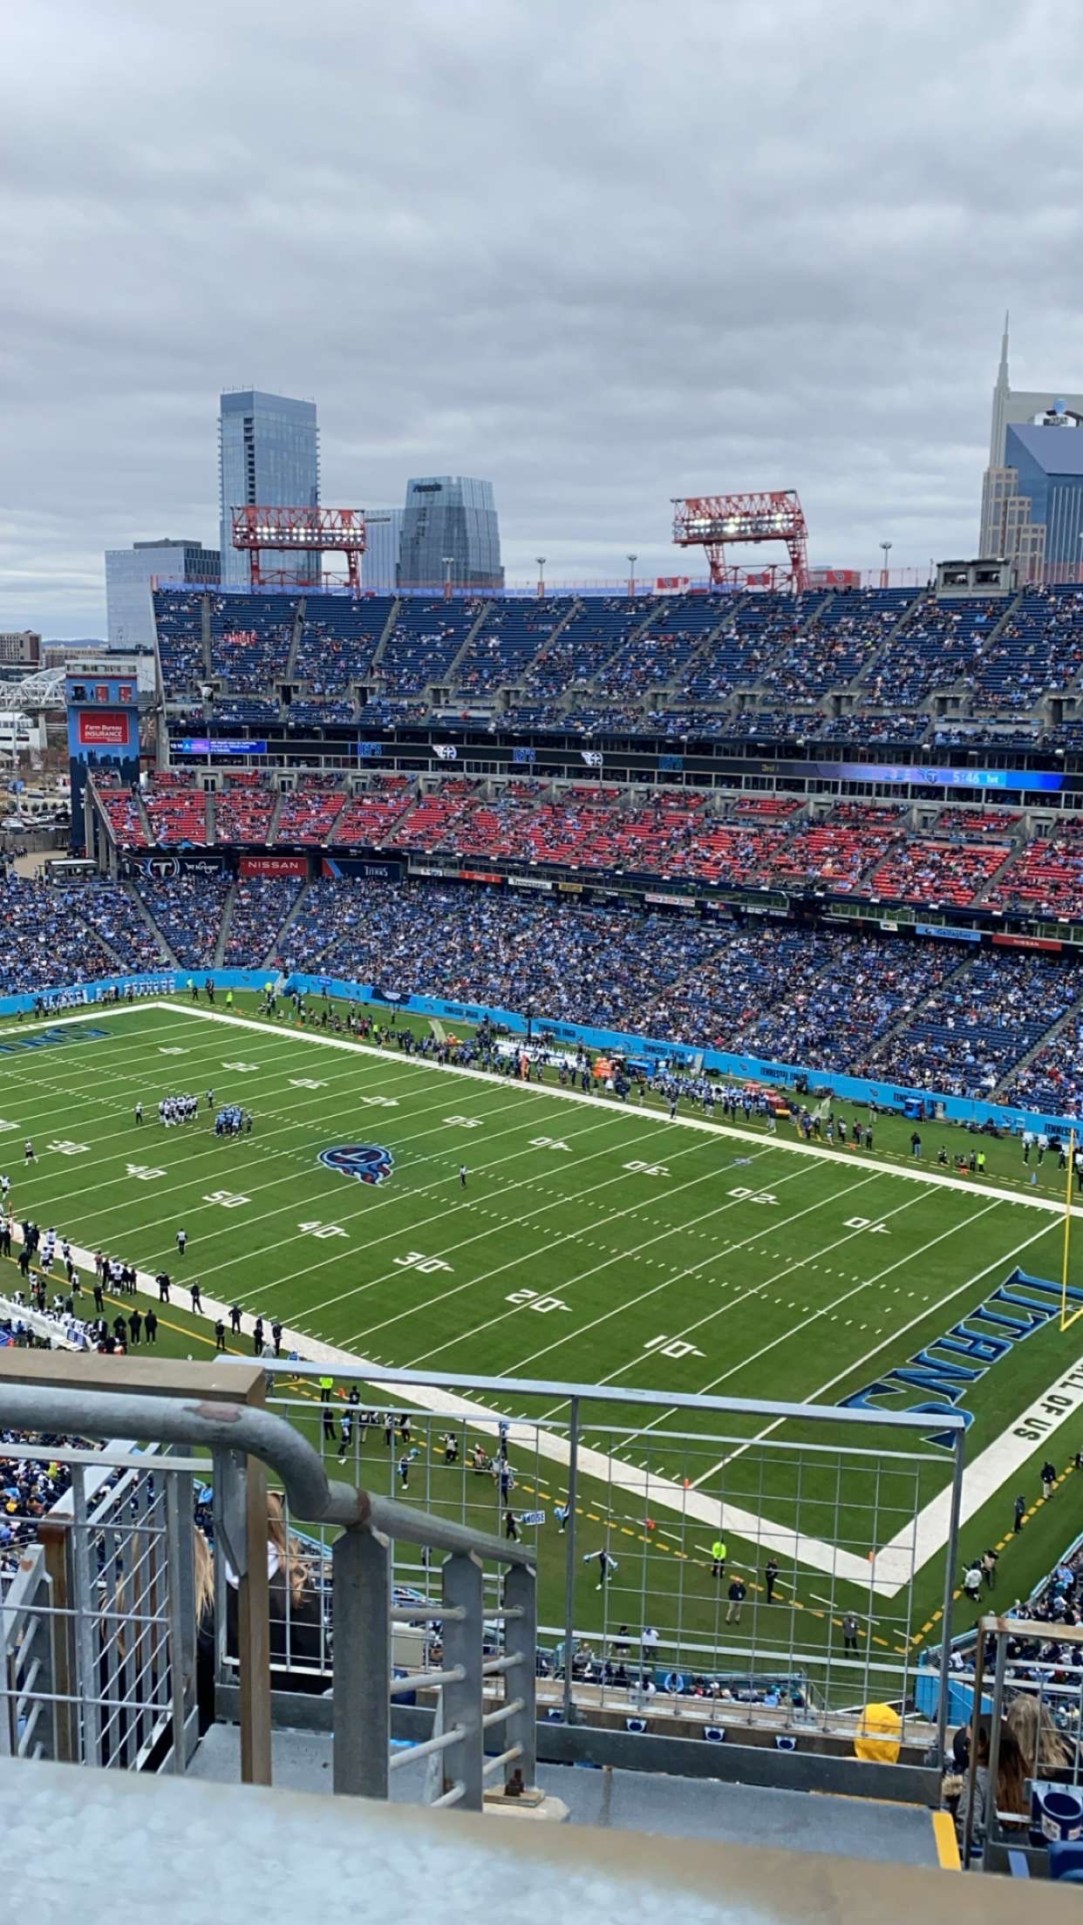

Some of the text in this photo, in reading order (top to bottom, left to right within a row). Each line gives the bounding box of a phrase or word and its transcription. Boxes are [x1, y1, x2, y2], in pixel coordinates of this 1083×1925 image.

[953, 771, 980, 784] 5:46
[248, 861, 299, 869] NISSAN
[125, 1165, 168, 1180] 40
[201, 1190, 252, 1208] 50
[297, 1221, 345, 1239] 40
[392, 1251, 450, 1274] 30
[504, 1289, 565, 1313] 20
[643, 1334, 698, 1359] 10
[1040, 1394, 1074, 1417] OF
[1012, 1417, 1053, 1441] US
